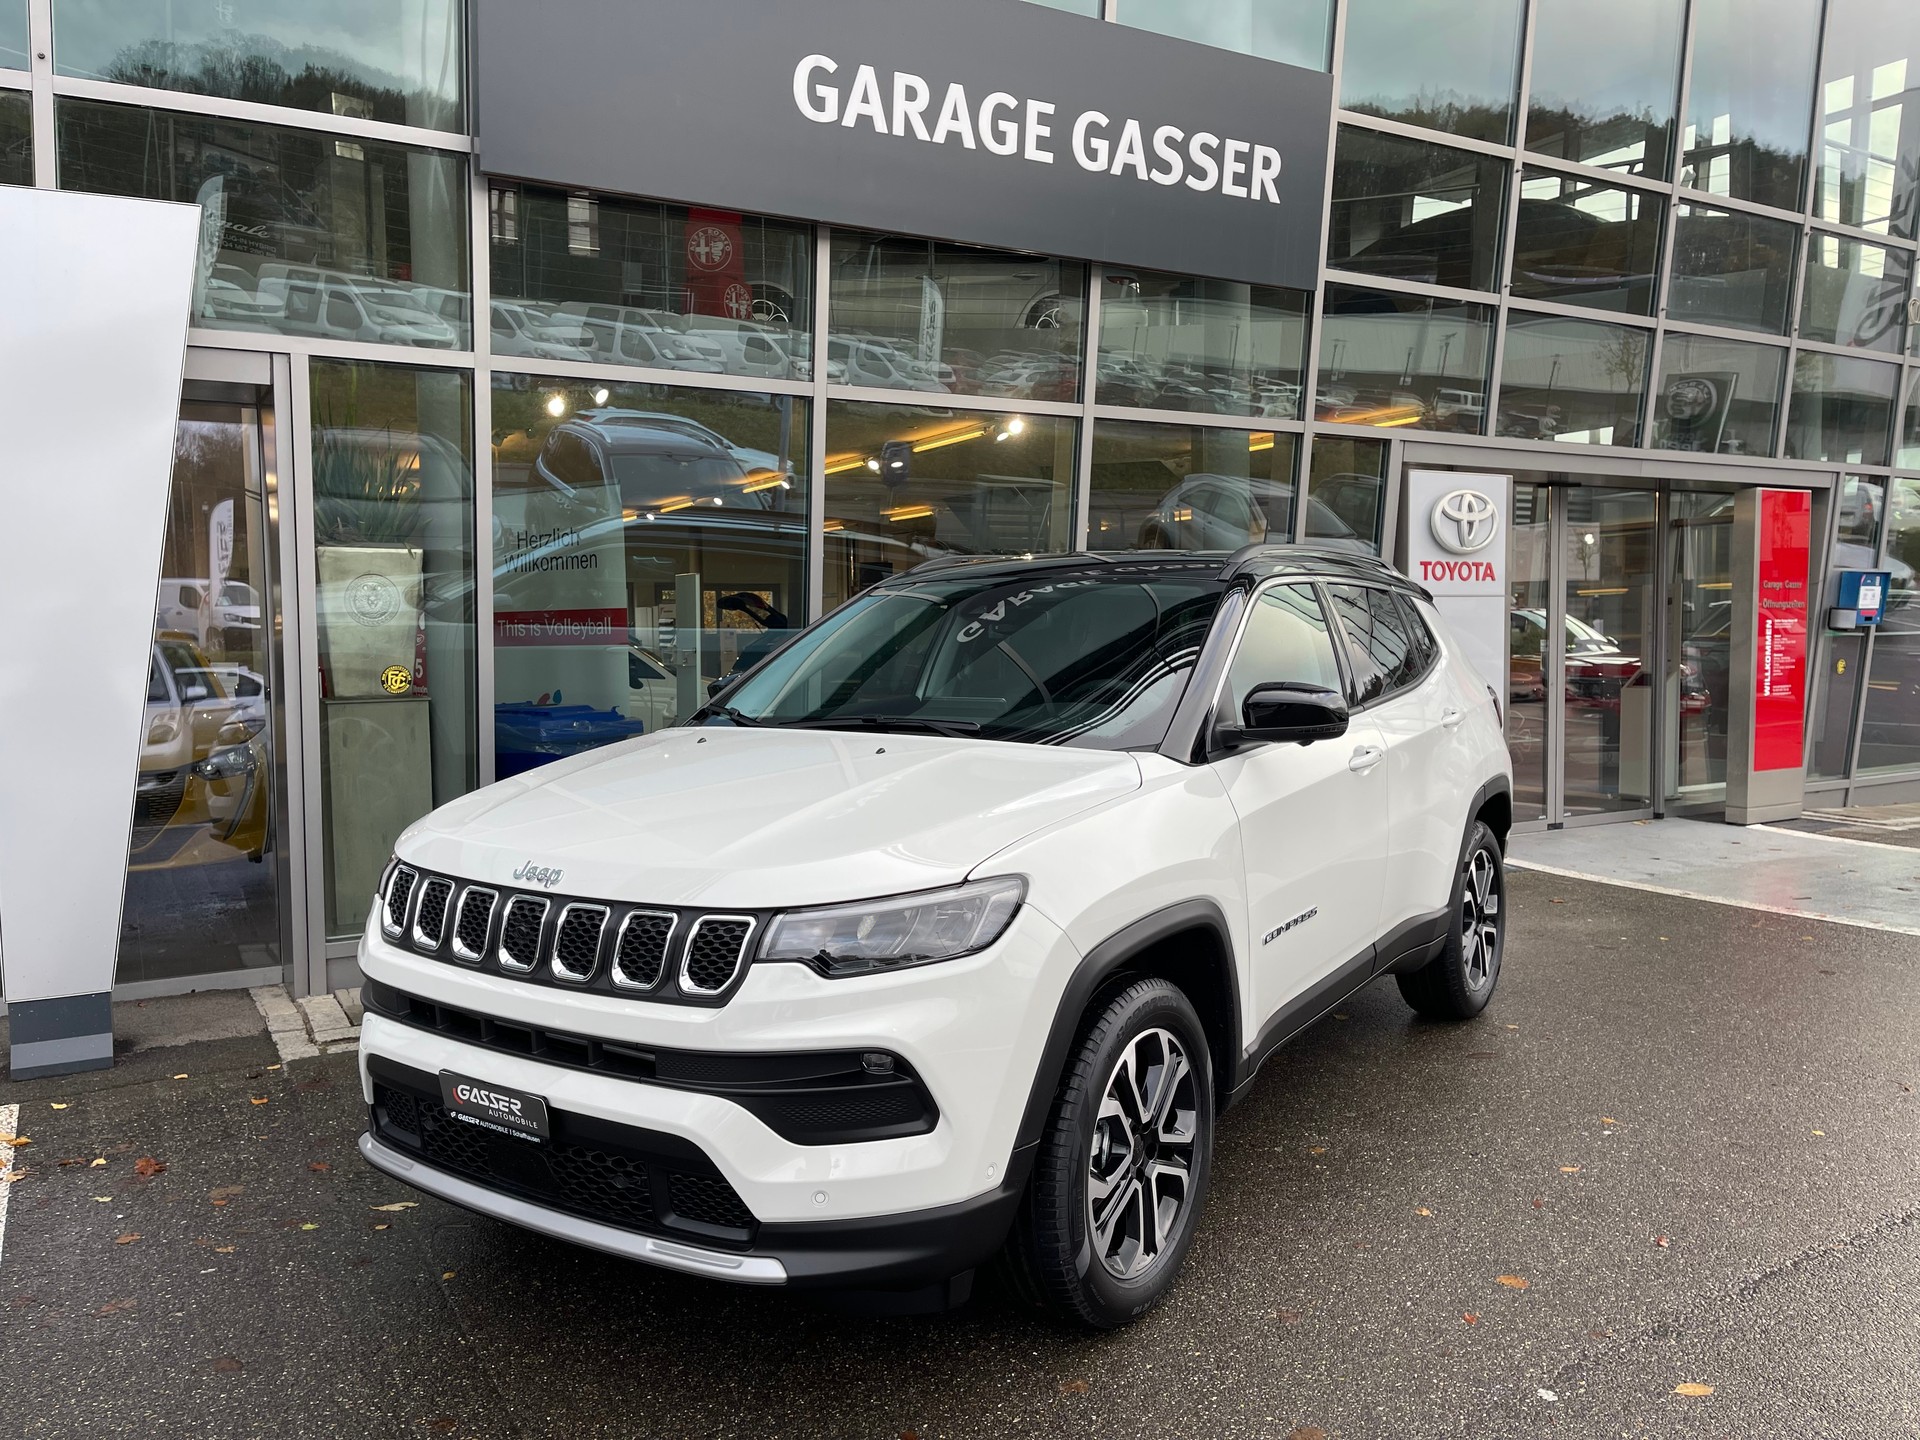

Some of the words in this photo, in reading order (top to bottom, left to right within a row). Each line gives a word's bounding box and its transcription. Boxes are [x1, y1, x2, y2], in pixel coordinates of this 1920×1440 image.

[793, 54, 1056, 164] GARAGE
[1072, 110, 1281, 204] GASSER
[516, 527, 580, 550] Herzlich
[504, 553, 598, 573] Willkommen
[1419, 561, 1496, 581] TOYOTA
[1763, 580, 1782, 590] Garage
[1762, 598, 1805, 611] Öffnungszeiten
[498, 620, 526, 636] This
[530, 619, 541, 636] is
[545, 617, 611, 639] Volleyball
[1764, 619, 1773, 696] WILLKOMMEN
[513, 860, 564, 888] Jeep
[1262, 905, 1318, 945] COMPASS
[457, 1084, 522, 1116] GASSER
[457, 1113, 480, 1126] GASSER
[480, 1121, 509, 1134] AUTOMOBILE
[513, 1130, 541, 1143] Schaffhausen
[489, 1109, 539, 1129] AUTOMOBILE
